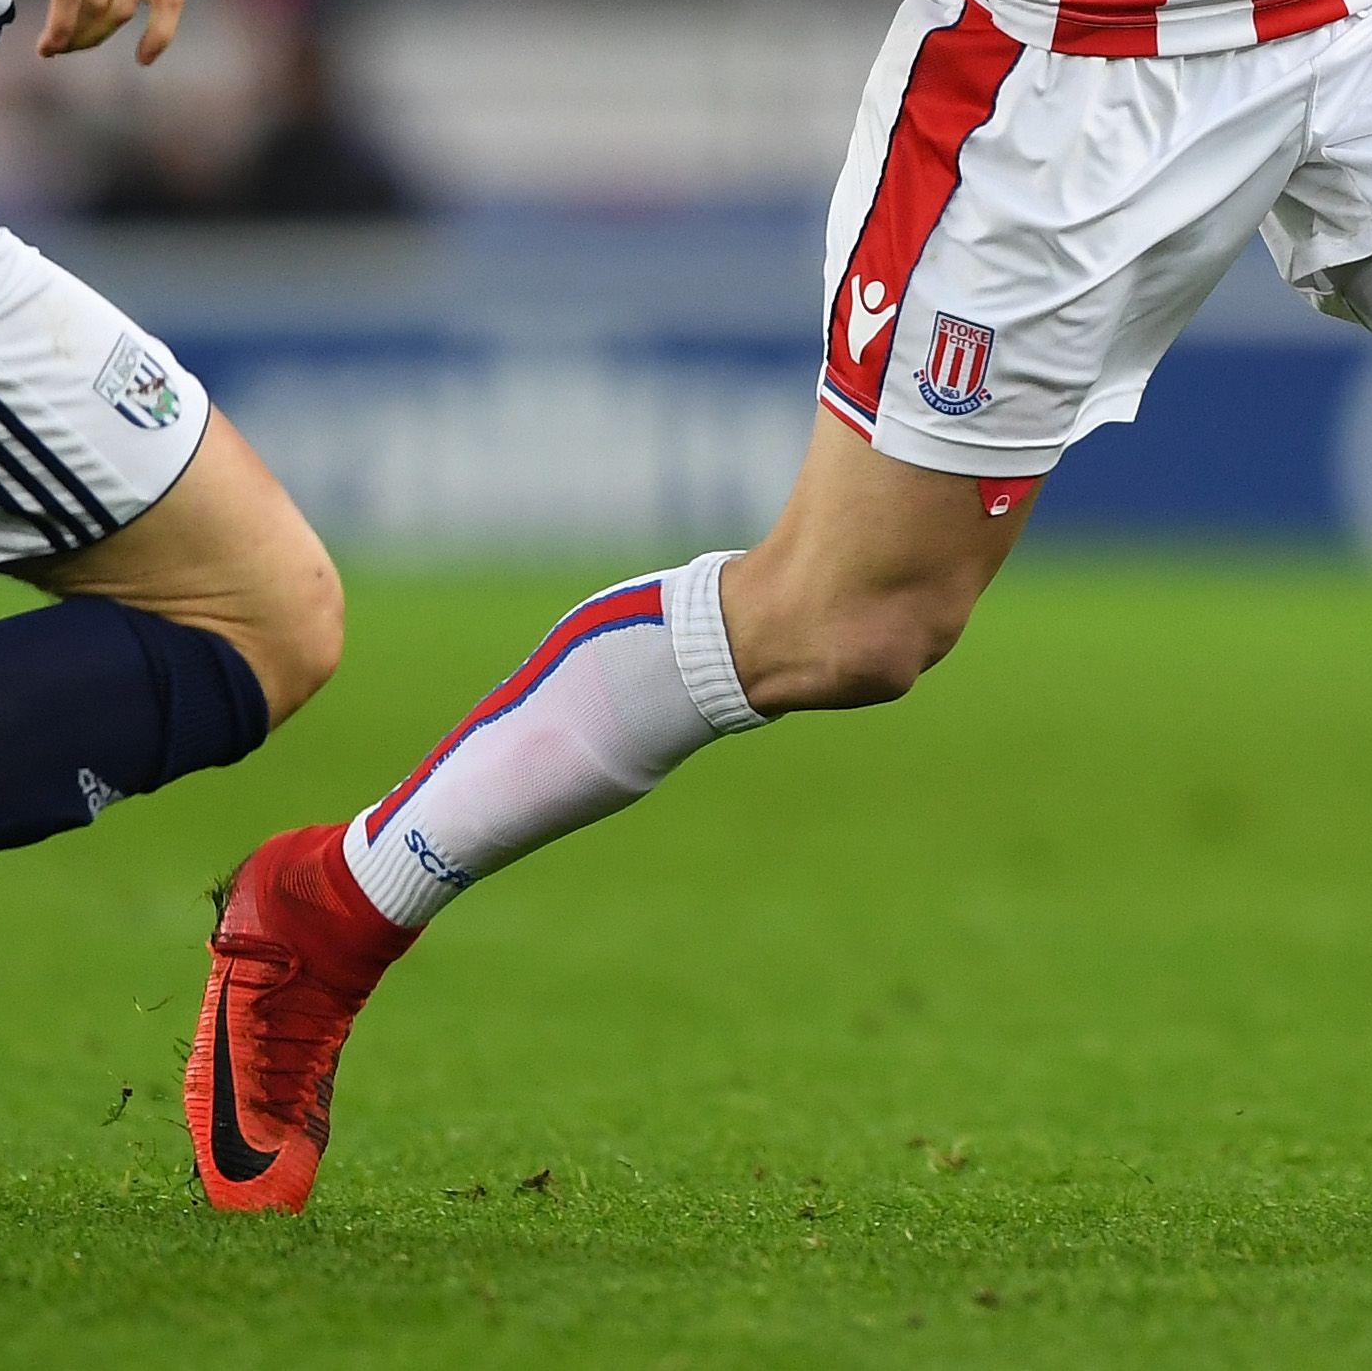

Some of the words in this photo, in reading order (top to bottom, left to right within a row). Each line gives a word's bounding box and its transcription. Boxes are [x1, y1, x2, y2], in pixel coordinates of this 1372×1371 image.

[939, 318, 990, 344] STOKE
[949, 335, 975, 350] CITY
[921, 384, 936, 404] THE
[935, 399, 979, 414] POTTERS
[940, 386, 960, 400] 1863
